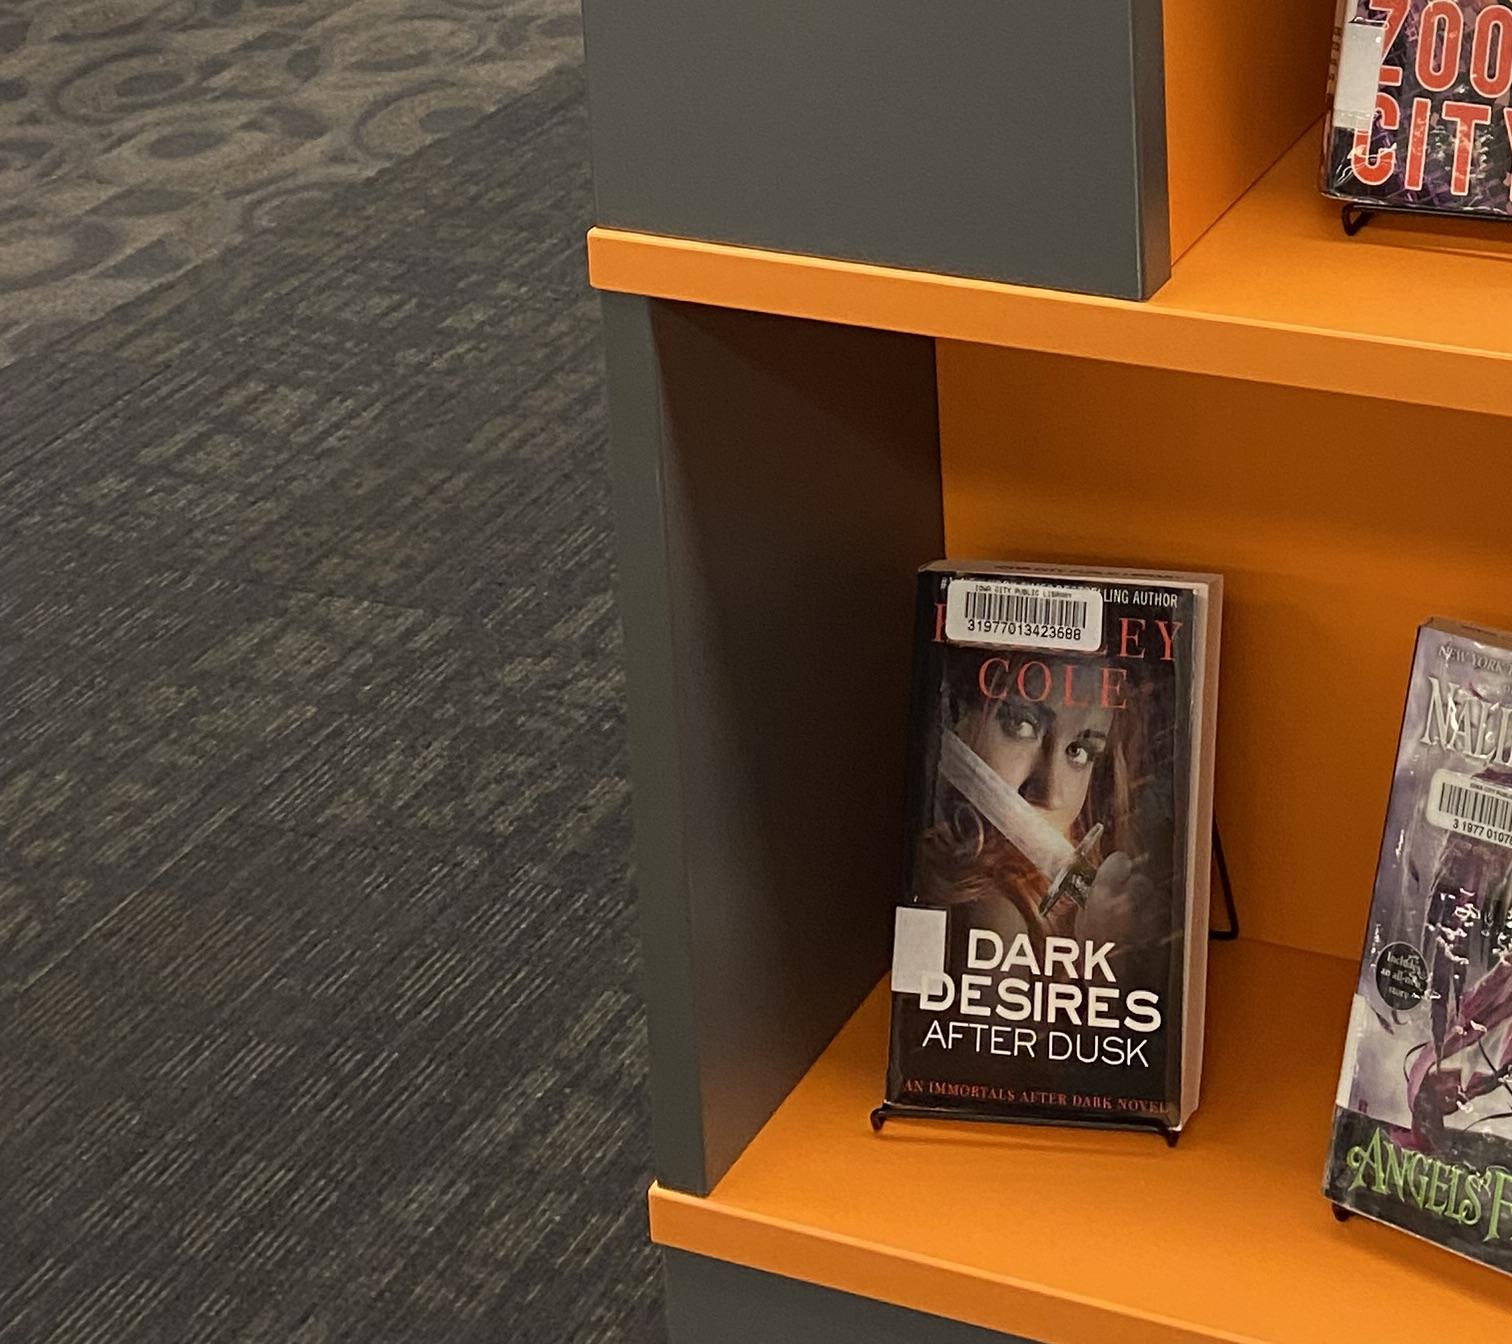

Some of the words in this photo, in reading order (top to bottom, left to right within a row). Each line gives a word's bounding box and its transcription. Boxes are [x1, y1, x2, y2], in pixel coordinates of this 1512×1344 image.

[1015, 588, 1039, 597] PUBLIC
[1133, 590, 1178, 608] AUTHOR
[1438, 644, 1469, 663] NEW
[1472, 652, 1504, 675] YORK
[978, 657, 1128, 709] COLE
[1453, 819, 1459, 829] 3
[1462, 821, 1485, 836] 1977
[967, 928, 1117, 983] DARK
[919, 971, 1162, 1033] DESIRES
[922, 1020, 1037, 1058] AFTER
[1049, 1032, 1149, 1068] DUSK
[903, 1079, 923, 1093] AN
[928, 1081, 1015, 1102] IMMORTALS
[1022, 1090, 1067, 1106] AFTER
[1072, 1094, 1112, 1110] DARK
